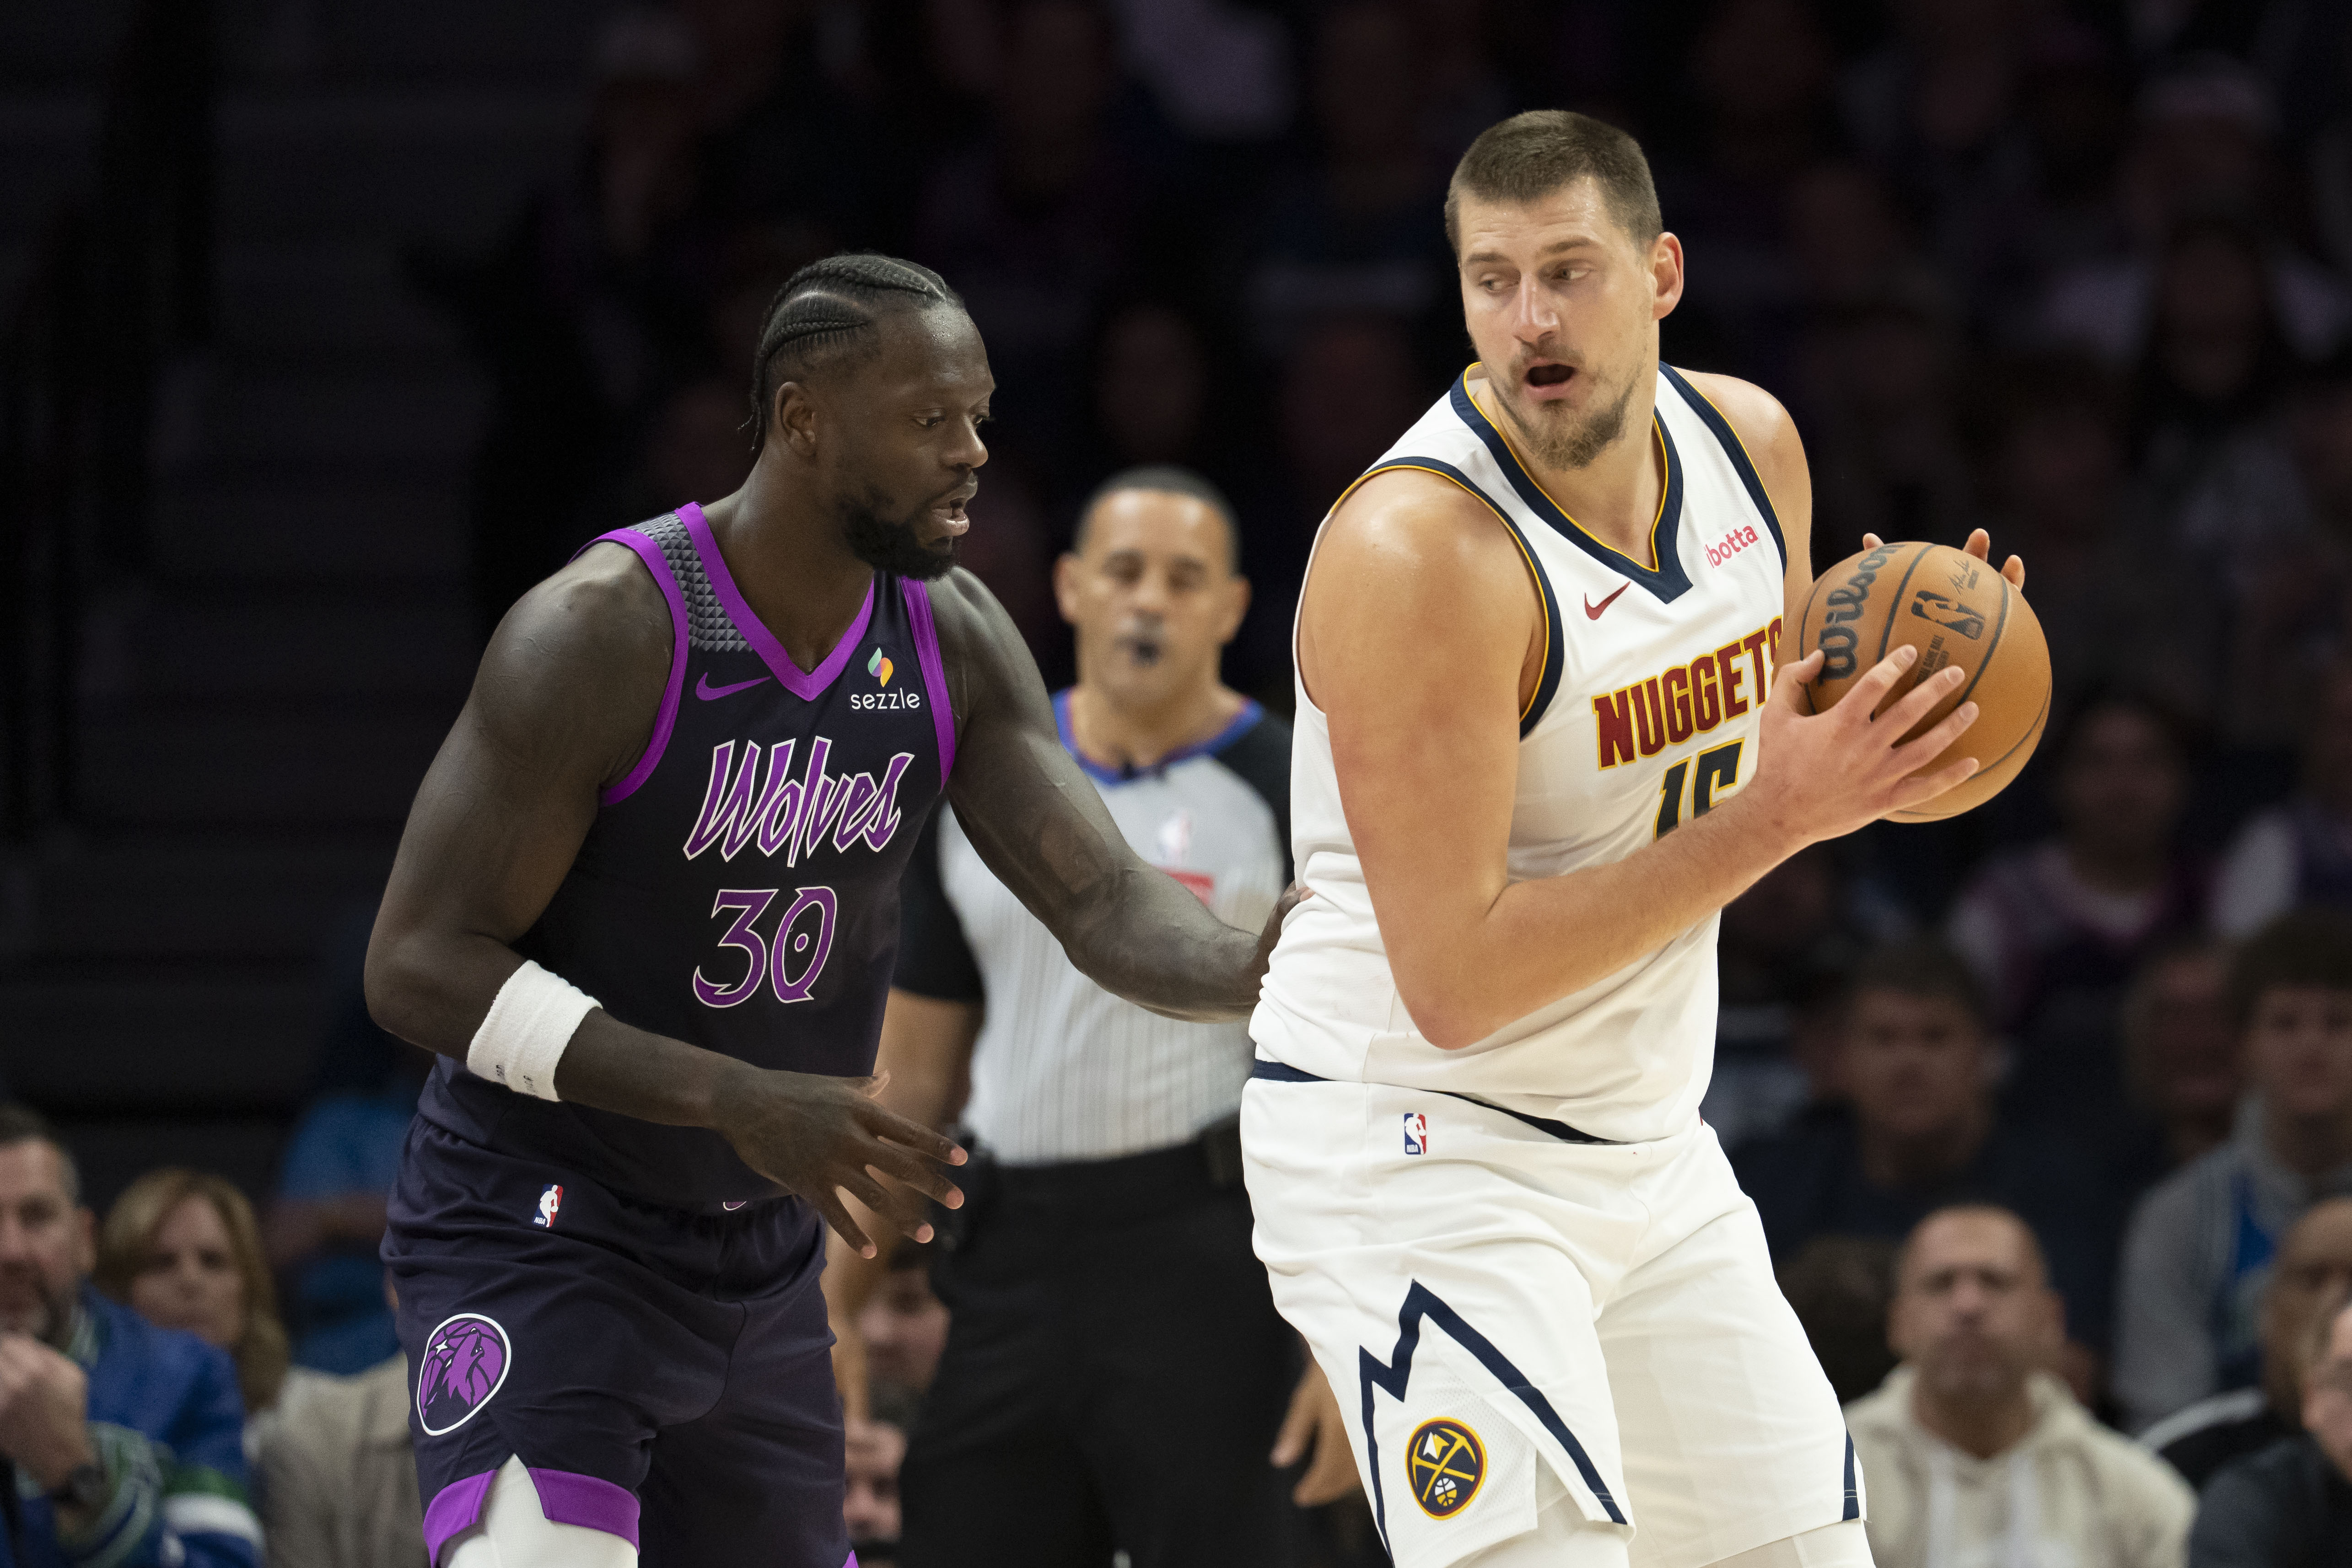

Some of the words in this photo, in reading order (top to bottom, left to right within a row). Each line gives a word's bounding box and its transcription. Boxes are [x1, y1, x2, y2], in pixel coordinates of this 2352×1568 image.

[1704, 526, 1758, 569] ibotta
[850, 688, 920, 710] sezzle
[683, 736, 915, 868] Wolves
[693, 886, 837, 1008] 30
[533, 1217, 546, 1225] NBA
